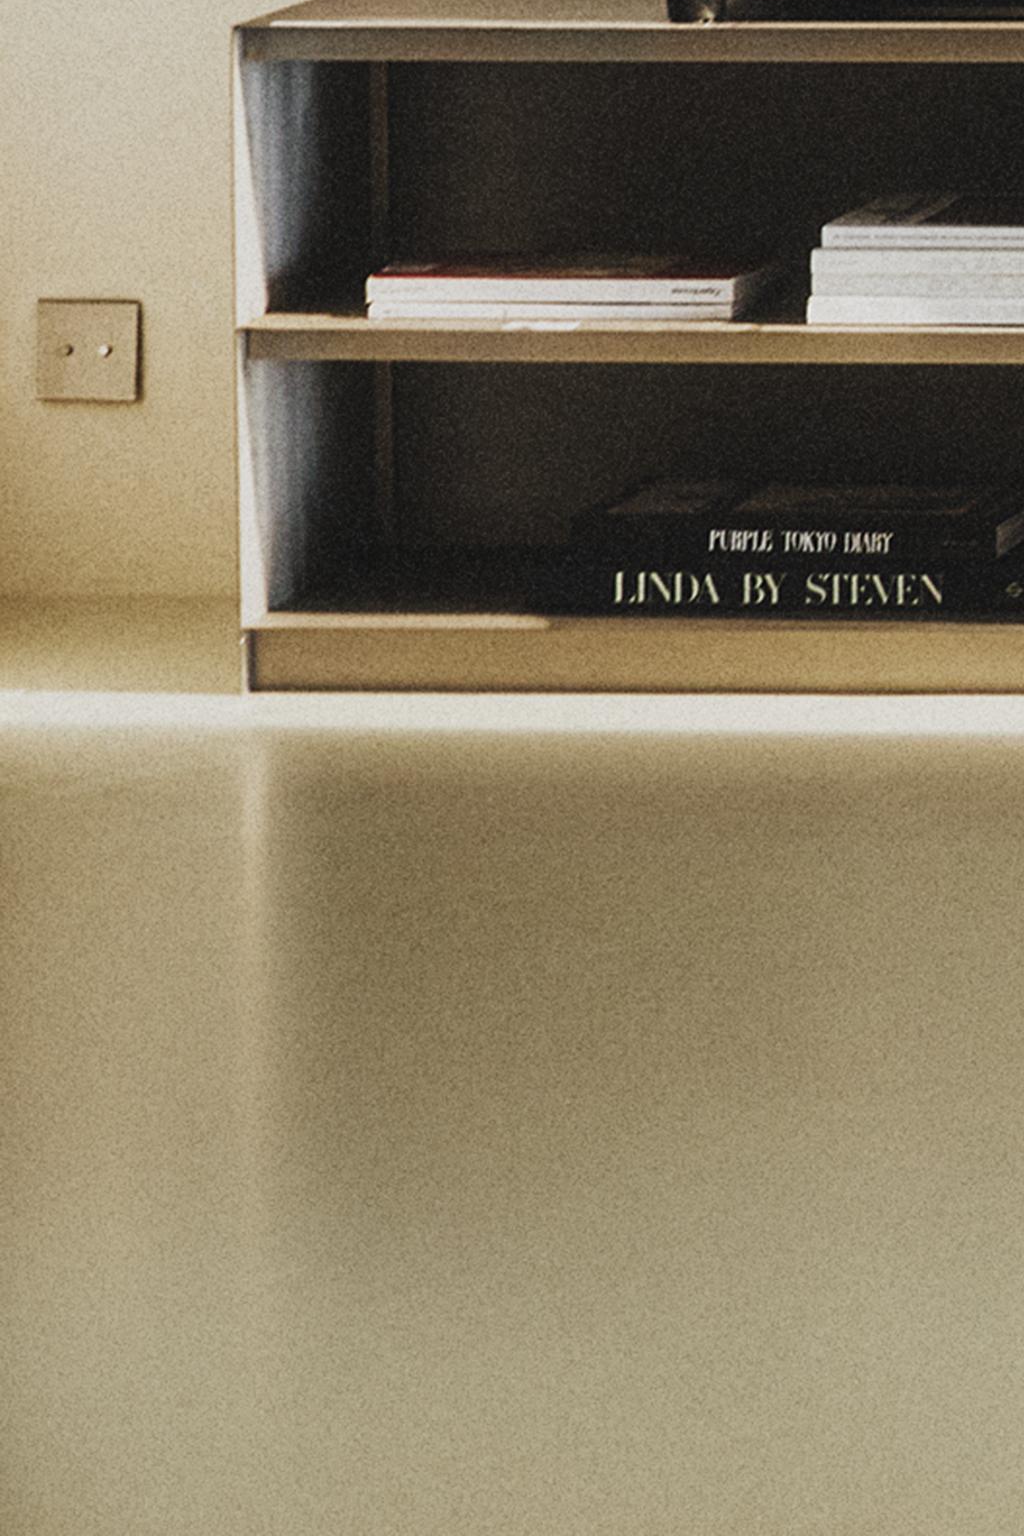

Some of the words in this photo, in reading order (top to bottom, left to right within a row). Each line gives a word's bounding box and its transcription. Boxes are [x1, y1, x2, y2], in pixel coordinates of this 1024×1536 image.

[708, 529, 774, 553] PURPLE
[780, 530, 837, 553] TOKYO
[844, 531, 894, 554] DIARY
[613, 570, 720, 605] LINDA
[742, 571, 787, 605] BY
[805, 572, 943, 606] STEVEN
